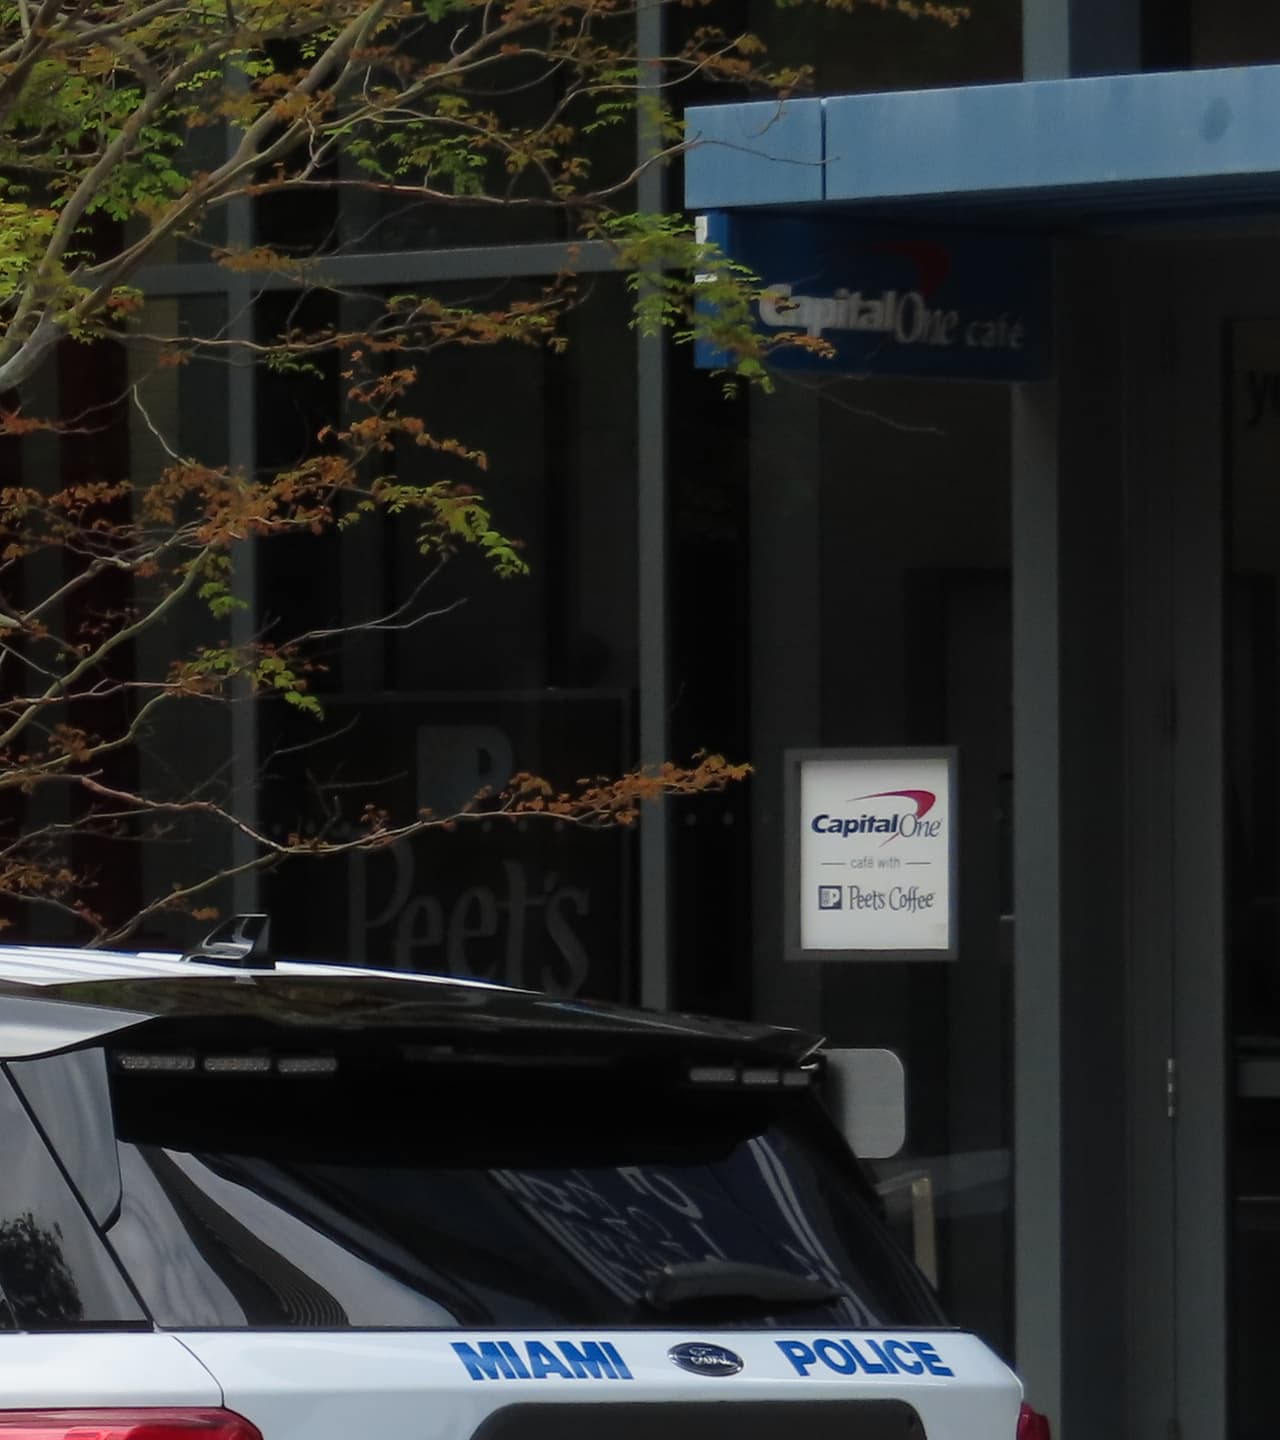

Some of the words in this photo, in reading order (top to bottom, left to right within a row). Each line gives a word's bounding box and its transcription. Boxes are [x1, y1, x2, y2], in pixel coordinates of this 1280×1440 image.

[965, 312, 1024, 349] café
[850, 857, 874, 869] café
[878, 857, 901, 869] with
[348, 830, 590, 999] Peet's
[848, 885, 885, 912] Peet's
[890, 886, 934, 913] Coffee
[450, 1341, 634, 1381] MIAMI
[774, 1339, 956, 1378] POLICE
